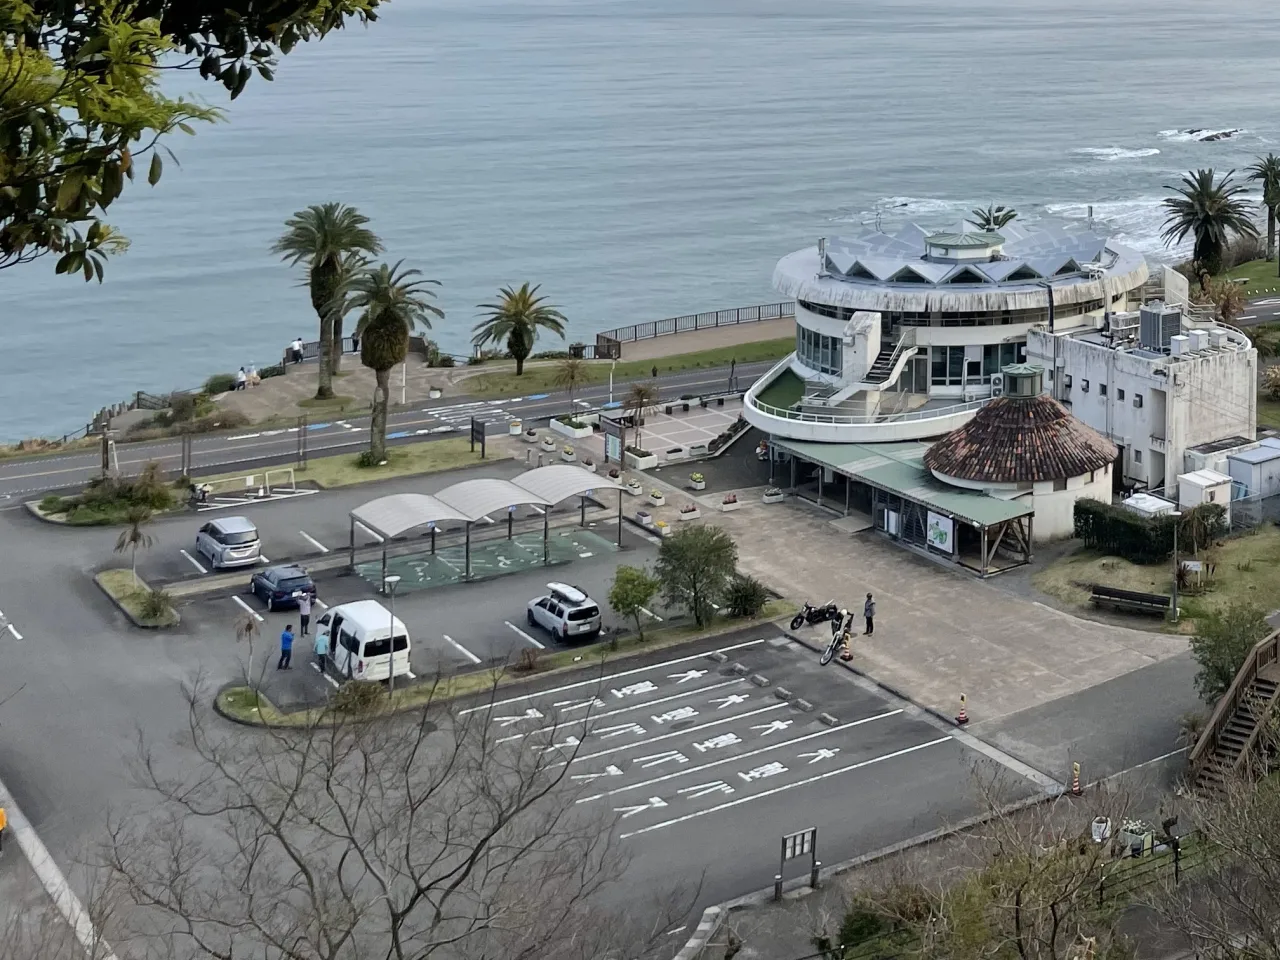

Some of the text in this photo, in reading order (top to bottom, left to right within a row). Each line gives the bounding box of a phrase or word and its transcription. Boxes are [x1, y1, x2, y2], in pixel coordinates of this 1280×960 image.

[494, 669, 709, 727] 大型バス
[531, 694, 749, 754] 大型バス
[570, 720, 793, 784] 大型バス
[613, 748, 841, 818] 大型バス
